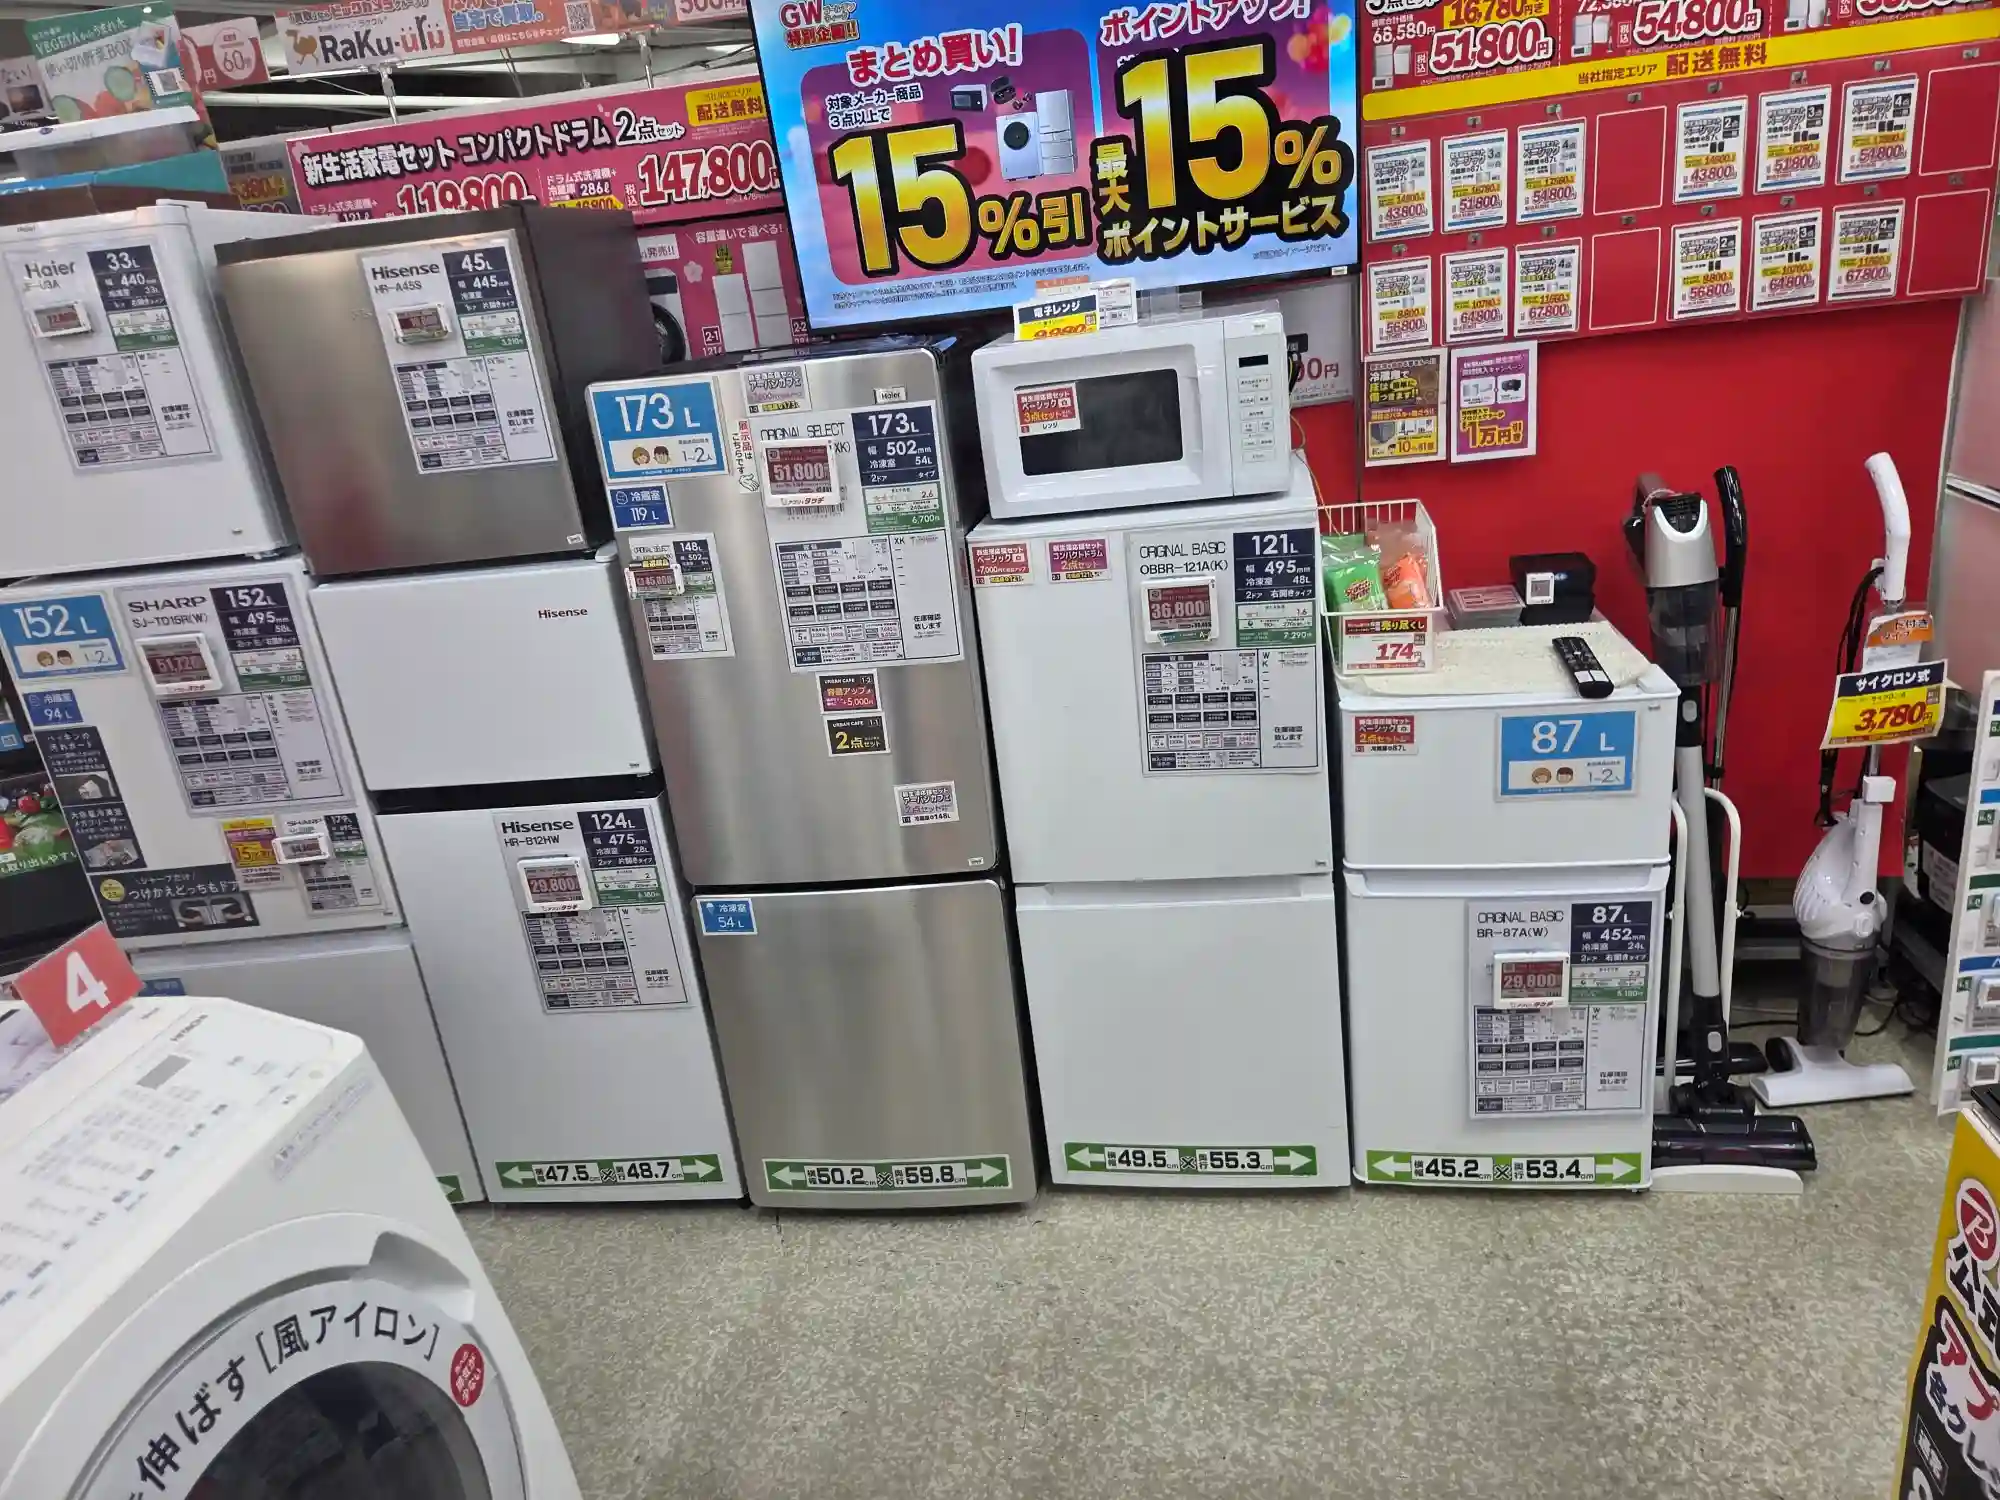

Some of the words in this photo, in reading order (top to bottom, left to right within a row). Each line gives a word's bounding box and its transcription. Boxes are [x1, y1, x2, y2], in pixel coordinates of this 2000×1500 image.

[780, 0, 822, 29] GW
[1101, 0, 1310, 45] ポイントアップ!
[1635, 0, 1760, 43] 54,800円
[847, 25, 1020, 85] まとめ買い!
[1432, 21, 1553, 74] 51,800円
[1577, 64, 1658, 85] 当社指定エリア
[1665, 42, 1768, 78] 配送無料
[827, 85, 923, 112] 対象メーカー商品
[695, 96, 765, 122] 配送無料
[828, 108, 891, 129] 3点以上で
[1122, 44, 1343, 210] 15%
[301, 137, 455, 188] 新生活家電セット
[458, 117, 610, 162] コンパクトドラム
[613, 107, 685, 146] 2点セット
[1096, 142, 1131, 215] 最大
[624, 184, 638, 207] 税込
[832, 123, 1086, 272] 15%引
[1103, 196, 1342, 258] ポイントサービス
[24, 260, 77, 280] Haier
[106, 251, 141, 271] 33L
[460, 252, 493, 272] 45L
[371, 262, 440, 281] Hisense
[374, 280, 423, 295] HR-A45S
[1033, 300, 1081, 319] 電子レンジ
[615, 393, 675, 433] 173
[684, 407, 701, 428] L
[806, 422, 845, 439] SELECT
[867, 412, 920, 436] 173L
[1042, 421, 1058, 430] レンジ
[738, 420, 753, 460] 展示品は
[886, 439, 932, 456] 502mm
[732, 432, 746, 474] こちらです
[869, 458, 897, 469] 冷凍室
[915, 455, 933, 466] 54L
[773, 461, 825, 482] 51,800
[870, 473, 888, 483] 2ドア
[917, 470, 935, 479] タイプ
[630, 490, 661, 502] 冷蔵室
[920, 490, 935, 499] 2.6
[630, 506, 648, 522] 119
[893, 536, 906, 546] XK
[1251, 533, 1299, 556] 121L
[977, 553, 1012, 564] ベーシック
[1061, 560, 1100, 570] 2点セット
[1139, 559, 1229, 575] OBBR-121A(K)
[1264, 559, 1311, 575] 495mm
[1245, 577, 1274, 587] 冷凍室
[1292, 575, 1312, 585] 48L
[225, 588, 277, 609] 152L
[1245, 590, 1263, 599] 2ドア
[1270, 589, 1313, 599] 右開きタイプ
[128, 595, 207, 613] SHARP
[538, 606, 589, 619] Hisense
[1151, 600, 1206, 619] 36,800
[13, 604, 77, 640] 152
[79, 615, 98, 635] L
[913, 613, 942, 623] 在庫確認
[914, 621, 943, 631] 致します
[1380, 619, 1425, 632] 売り尽くし
[1375, 642, 1422, 661] 174円
[1856, 668, 1931, 692] サイクロン式
[44, 708, 63, 721] 94
[1854, 701, 1934, 733] 3,780円
[835, 731, 881, 750] 2点セット
[1531, 719, 1583, 754] 87
[1599, 731, 1616, 752] L
[501, 817, 574, 834] Hisense
[591, 811, 636, 831] 124L
[530, 877, 577, 893] 29,800
[717, 916, 736, 928] 54
[1592, 905, 1631, 924] 87L
[1476, 927, 1549, 940] BR-87A(W)
[1599, 928, 1646, 942] 452mm
[1627, 941, 1645, 951] 24L
[66, 950, 111, 1008] 4
[1503, 974, 1557, 991] 29,800
[1117, 1149, 1180, 1170] 49.5cm
[1209, 1150, 1274, 1171] 55.3cm
[1425, 1158, 1492, 1179] 45.2cm
[1525, 1158, 1594, 1180] 53.4cm
[627, 1161, 683, 1180] 48.7cm
[816, 1167, 877, 1186] 50.2cm
[904, 1165, 966, 1185] 59.8cm
